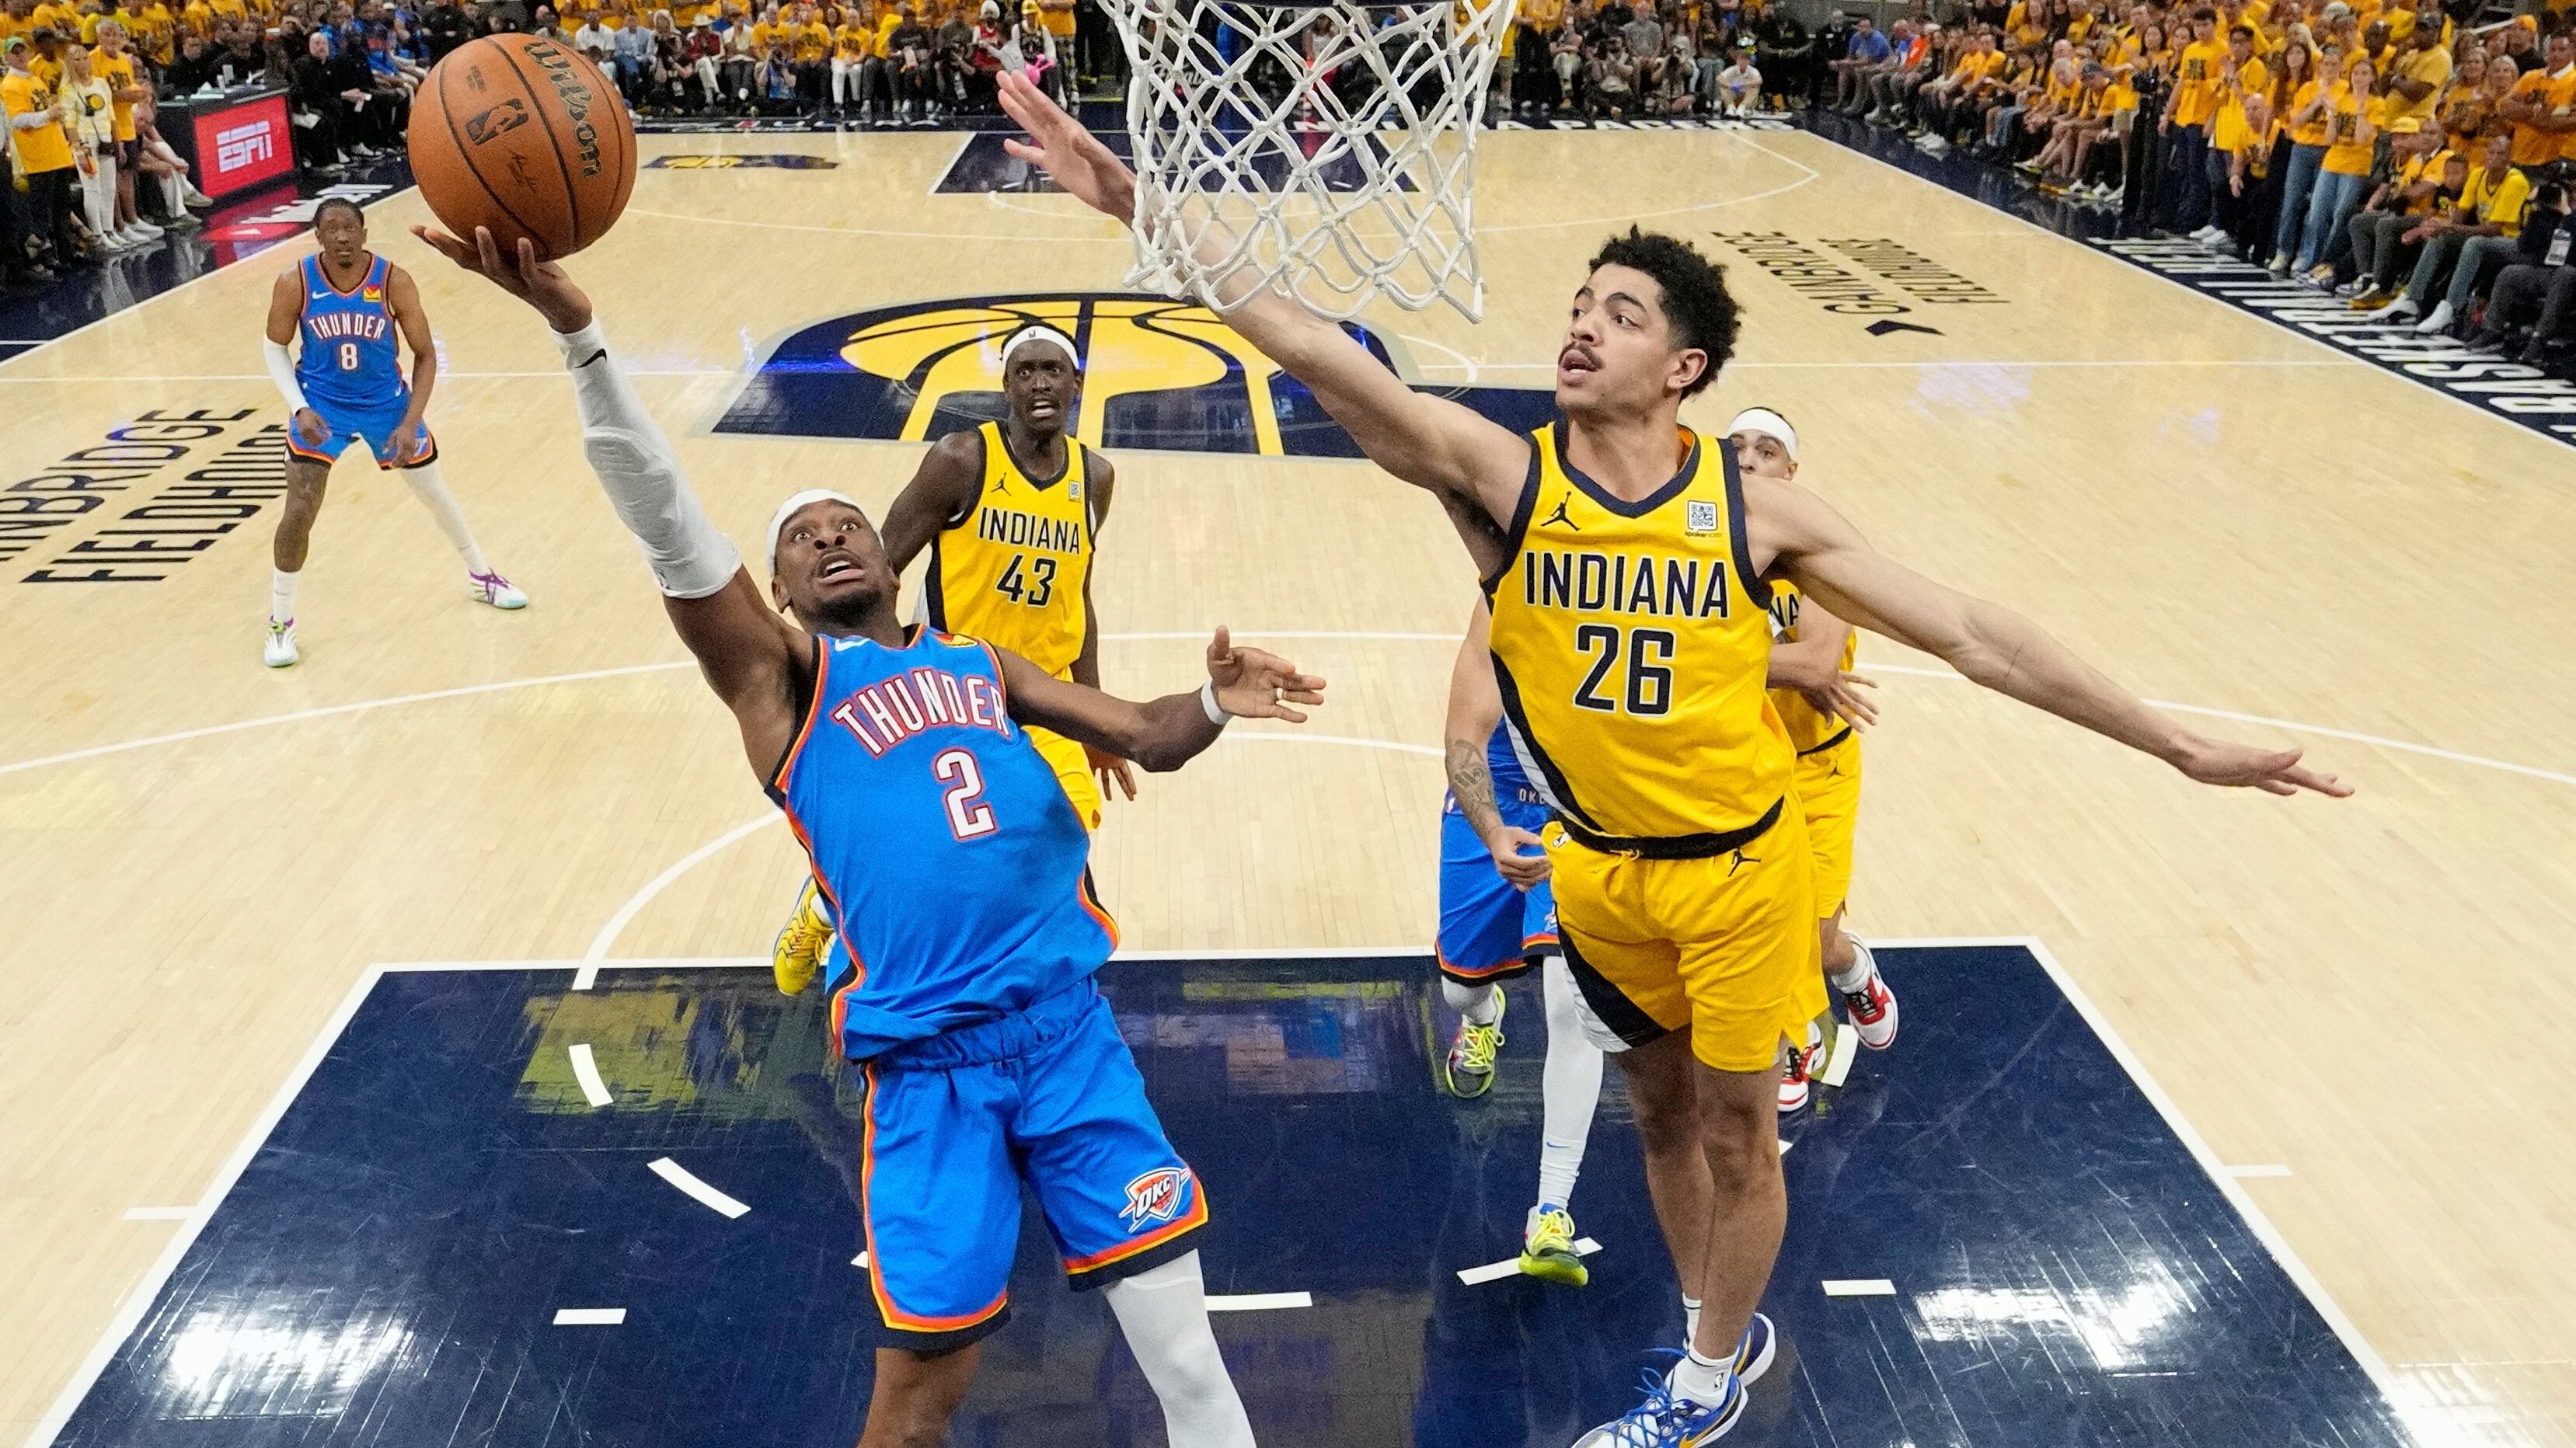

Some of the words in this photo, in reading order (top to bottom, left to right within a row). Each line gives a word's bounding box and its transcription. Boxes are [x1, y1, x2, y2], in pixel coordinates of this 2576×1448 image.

[521, 41, 602, 179] Wilson
[1549, 120, 1795, 131] PACERS
[216, 120, 273, 173] ESPN
[1711, 231, 1912, 314] GAINBRIDGE
[307, 312, 387, 340] THUNDER
[340, 342, 359, 371] 8
[978, 506, 1082, 556] INDIANA
[995, 553, 1058, 608] 43
[1524, 550, 1731, 620] INDIANA
[1572, 623, 1677, 718] 26
[831, 668, 1011, 760] THUNDER
[933, 748, 998, 841] 2
[1135, 1176, 1171, 1218] OKC
